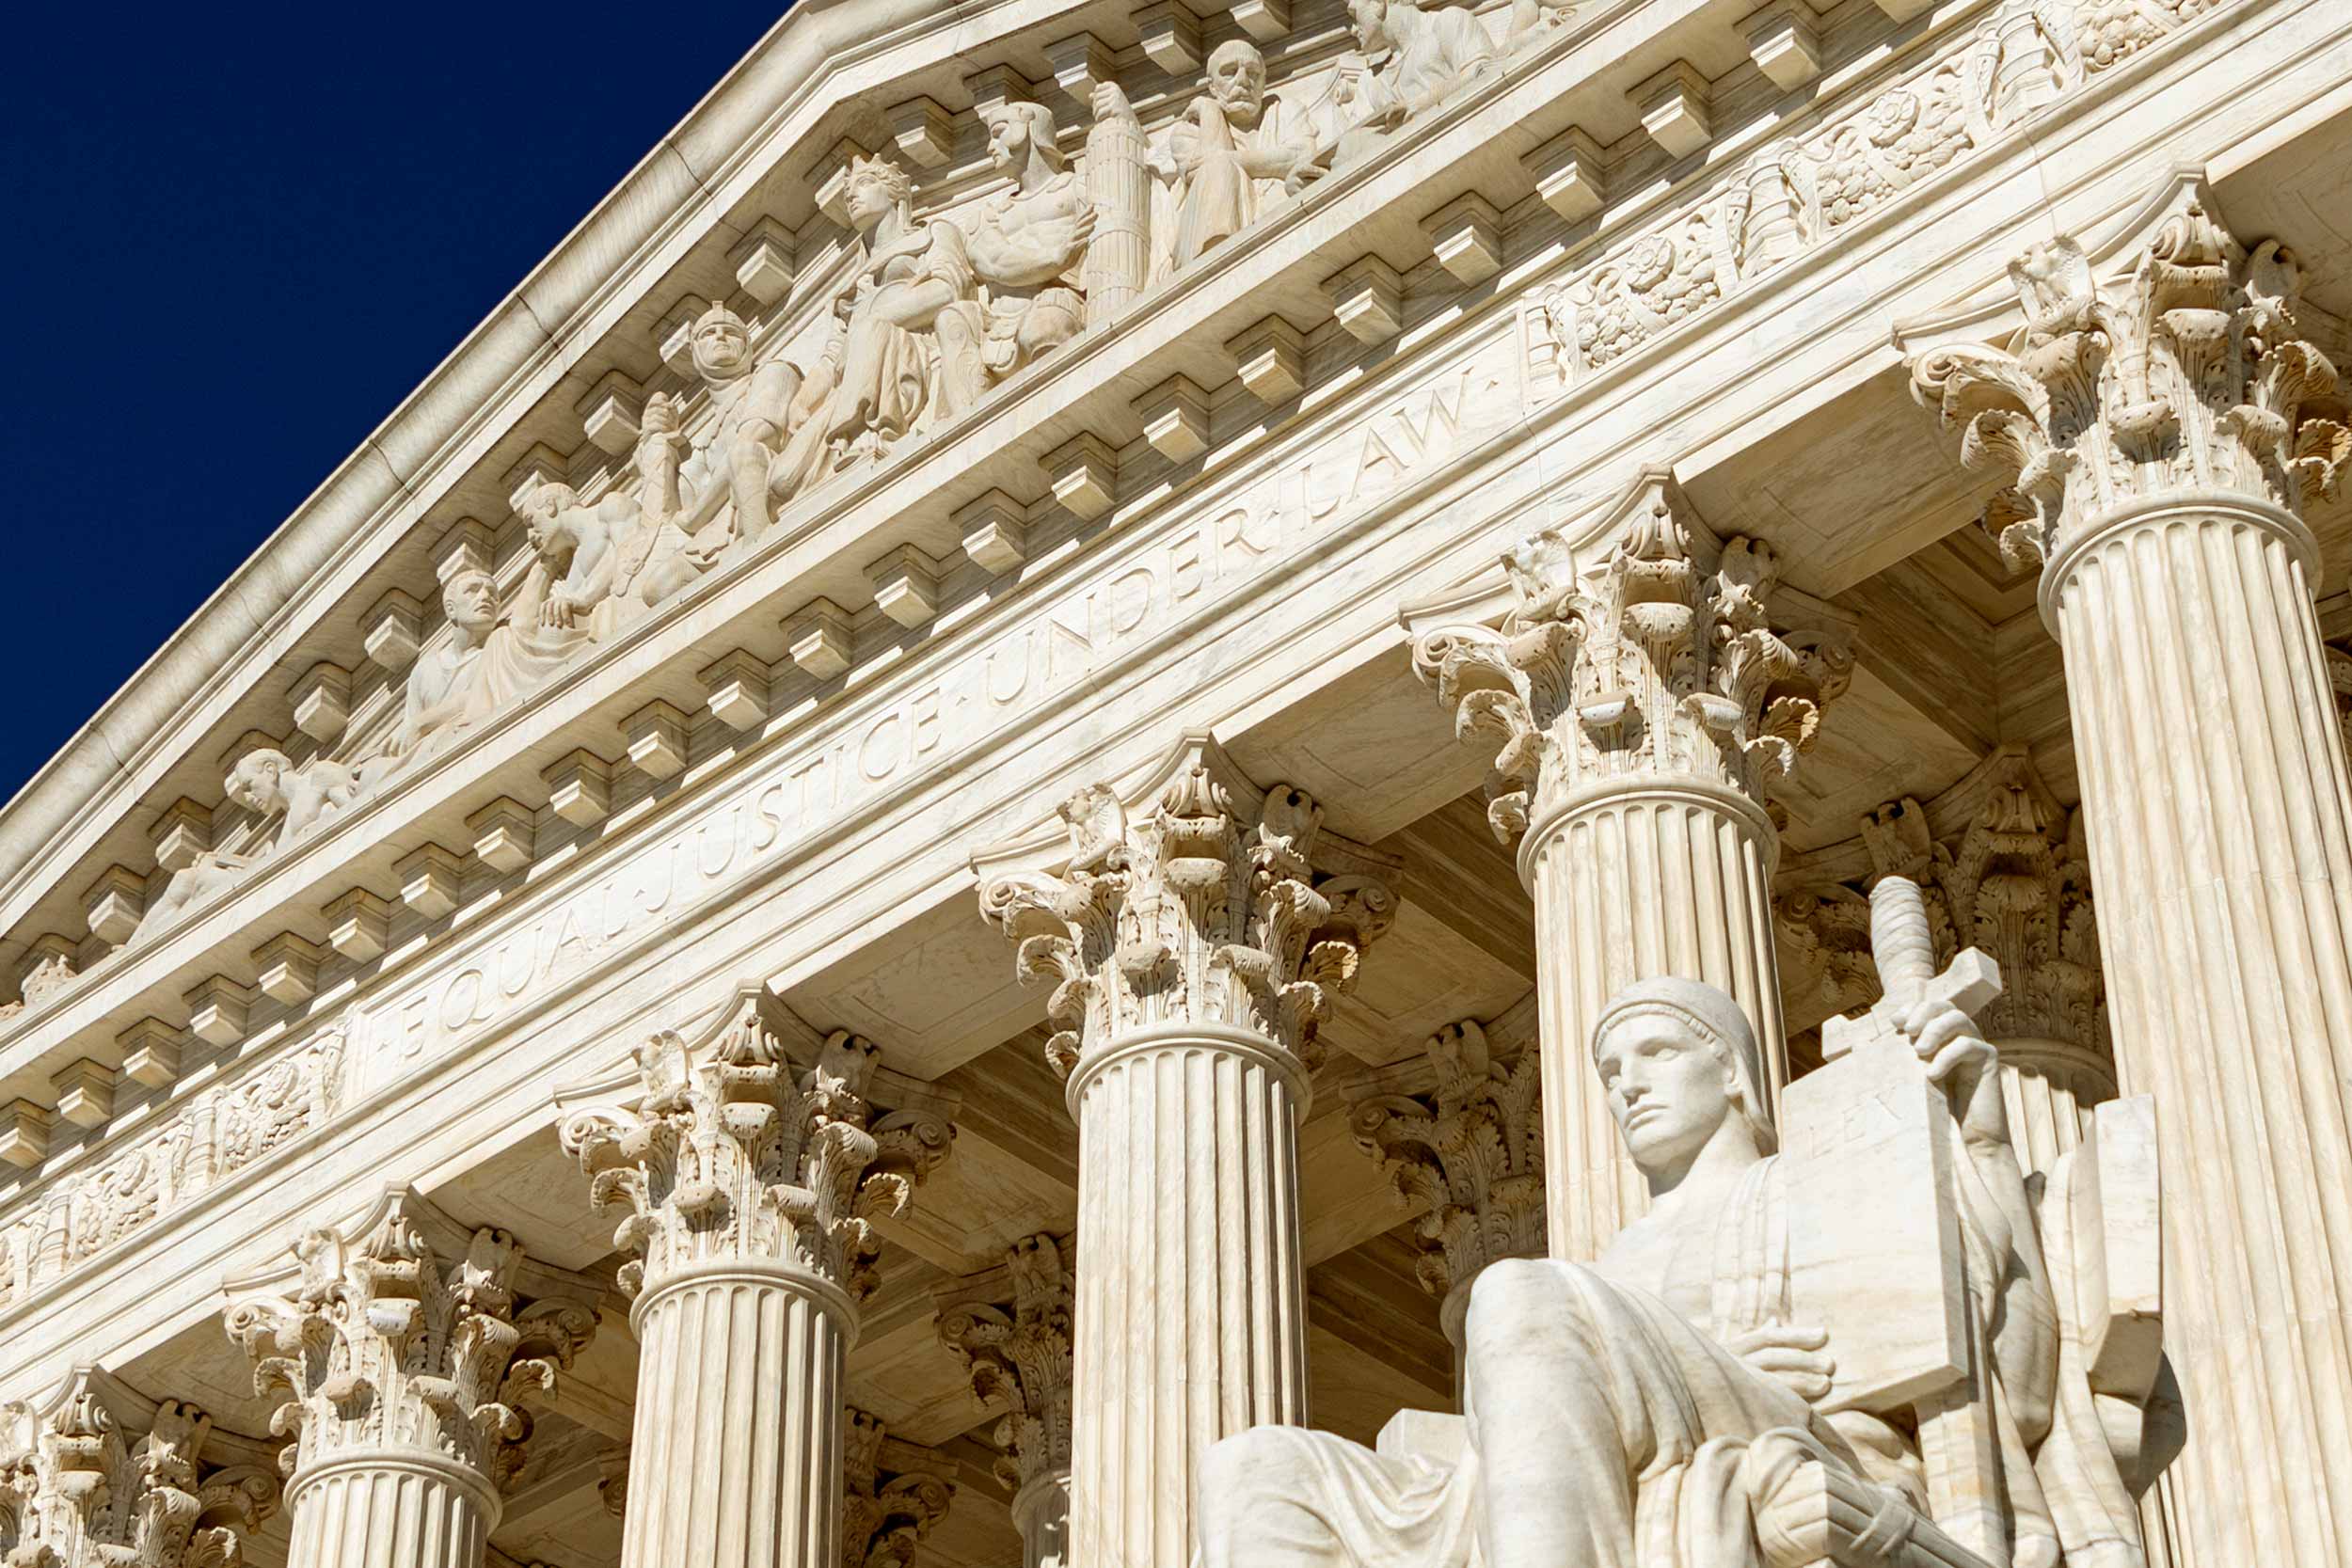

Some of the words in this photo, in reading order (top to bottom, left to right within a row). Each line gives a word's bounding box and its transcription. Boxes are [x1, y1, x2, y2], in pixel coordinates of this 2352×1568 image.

[401, 887, 629, 1056] EQUAL
[646, 687, 942, 912] JUSTICE
[985, 508, 1267, 707] UNDER
[1299, 365, 1475, 531] LAW
